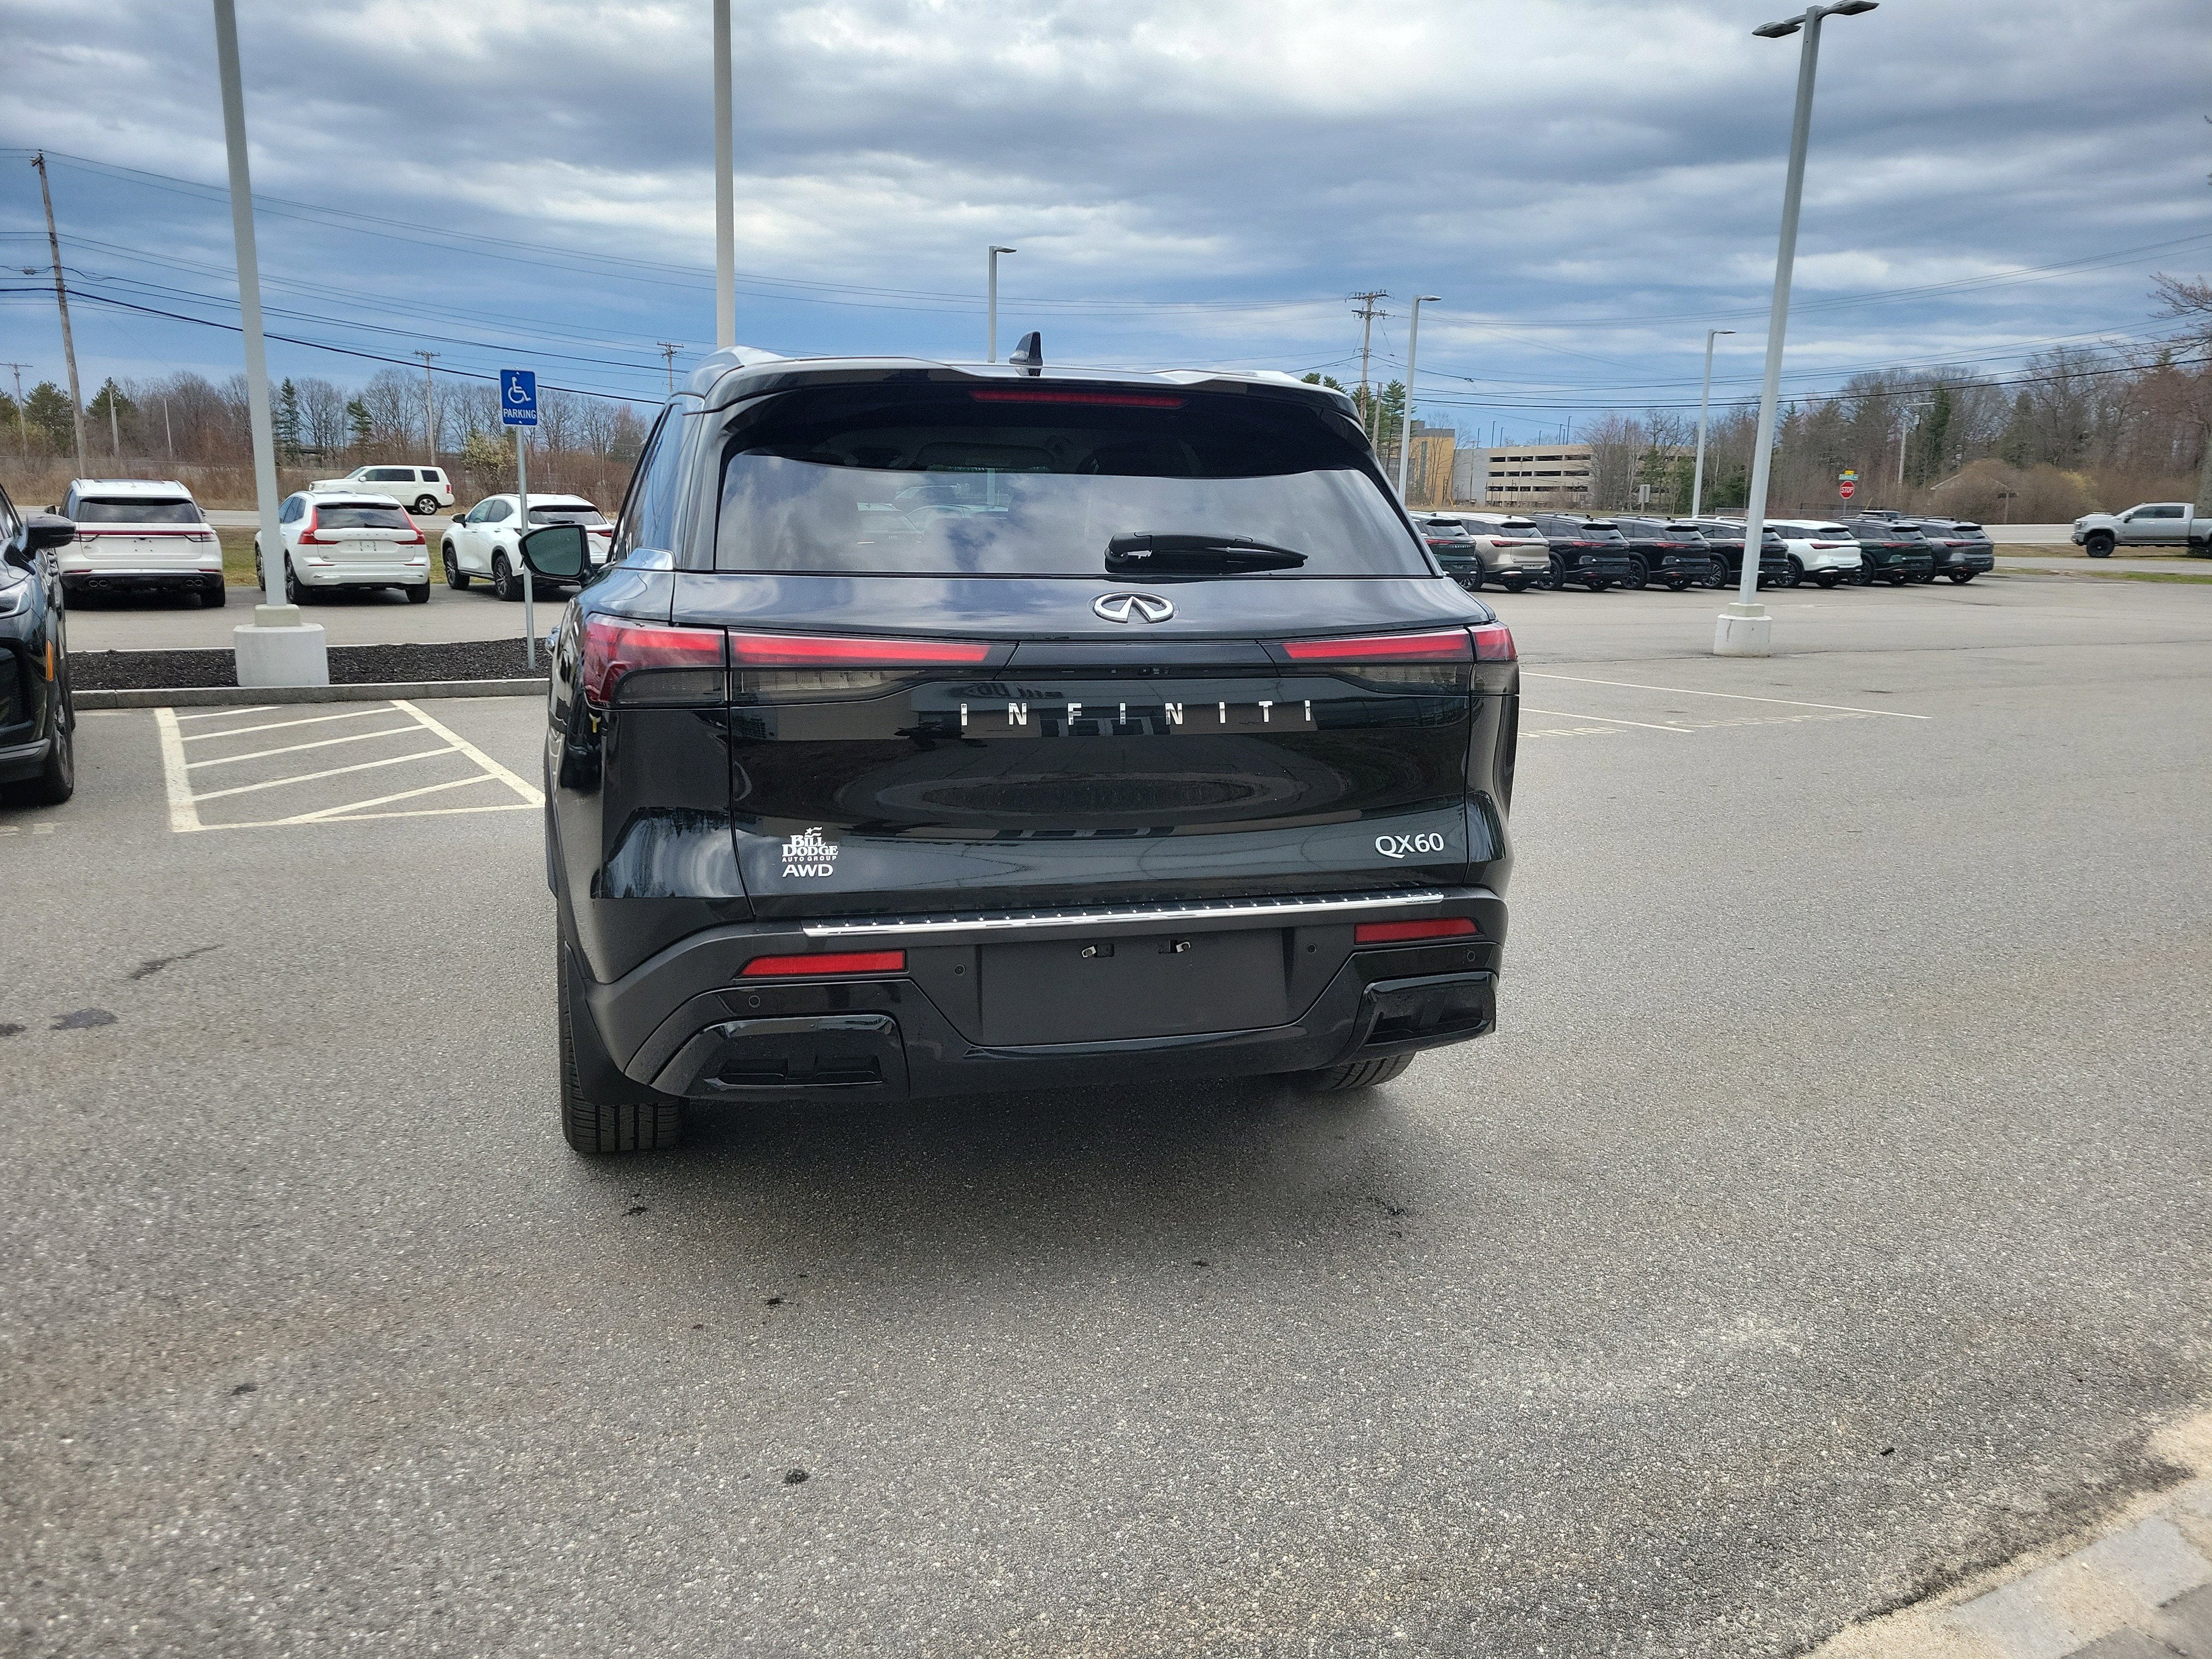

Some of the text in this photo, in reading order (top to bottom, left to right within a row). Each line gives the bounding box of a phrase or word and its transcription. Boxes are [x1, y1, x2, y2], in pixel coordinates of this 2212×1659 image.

[503, 408, 537, 419] PARKING
[960, 700, 1311, 726] INFINITI
[790, 834, 826, 847] BILL
[1375, 833, 1444, 859] QX60
[782, 844, 838, 857] DODGE
[782, 864, 833, 877] AWD
